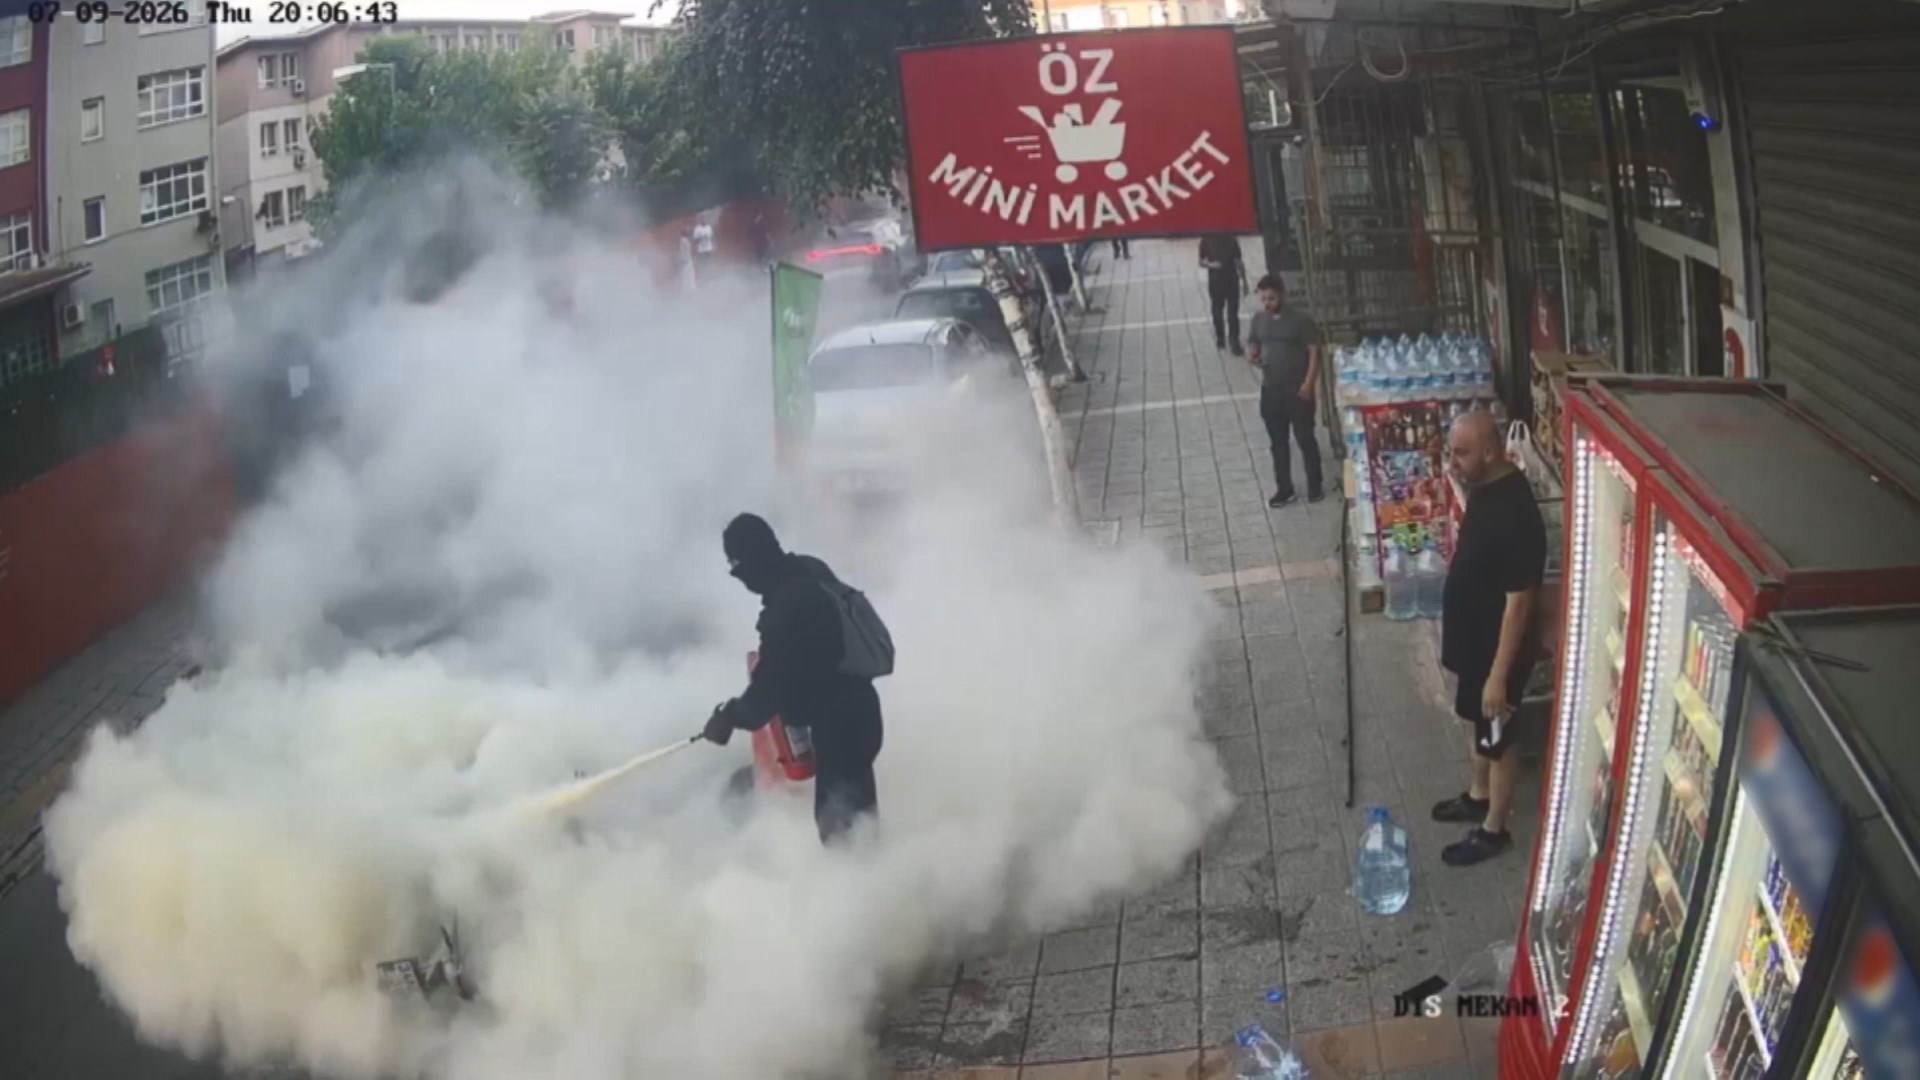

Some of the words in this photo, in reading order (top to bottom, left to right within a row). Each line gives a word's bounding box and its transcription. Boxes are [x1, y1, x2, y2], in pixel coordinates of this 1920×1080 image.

[1038, 43, 1118, 95] ÖZ
[928, 152, 1038, 225] MİNİ
[1049, 130, 1231, 230] MARKET
